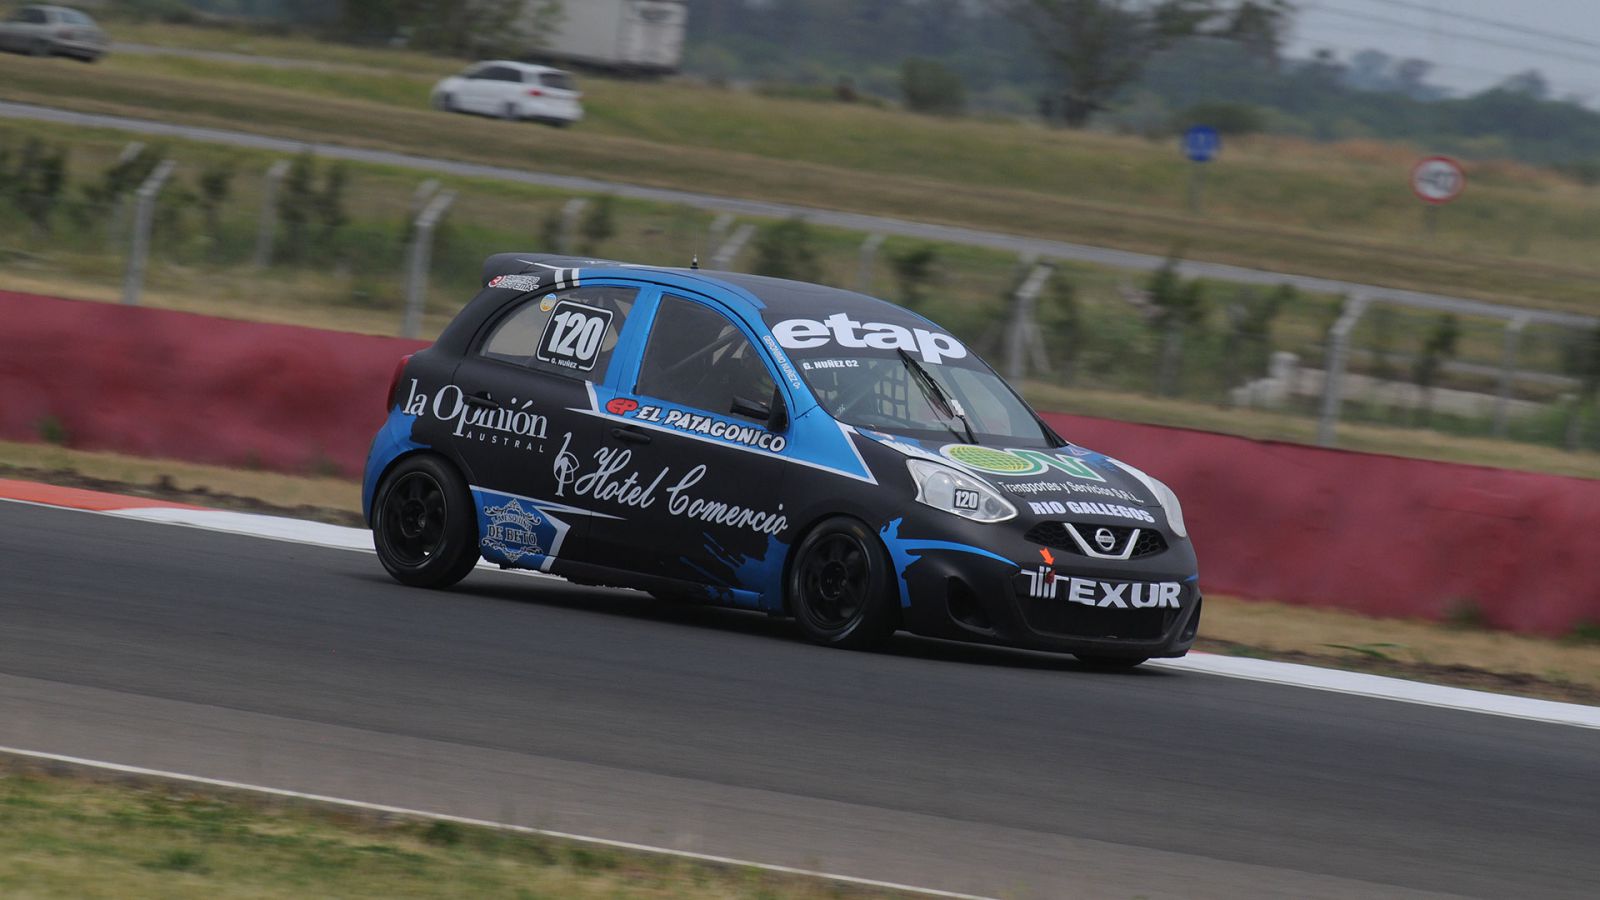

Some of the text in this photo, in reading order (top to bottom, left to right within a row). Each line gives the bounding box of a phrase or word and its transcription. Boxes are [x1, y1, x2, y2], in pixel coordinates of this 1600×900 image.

[547, 311, 605, 360] 120
[771, 312, 968, 365] etap
[802, 359, 860, 370] G. NUÑEZ C2
[402, 378, 548, 440] la Opinión
[635, 405, 661, 422] EL
[663, 409, 787, 453] PATAGONICO
[466, 431, 544, 453] AUSTRAL
[574, 446, 670, 509] Hotel
[666, 464, 789, 536] Comercio
[955, 490, 979, 509] 120
[997, 480, 1062, 495] Transportes
[1061, 482, 1071, 495] y
[1066, 481, 1115, 498] Servicios
[1028, 501, 1155, 523] RIO GALLEGOS
[486, 524, 538, 546] DE BETO
